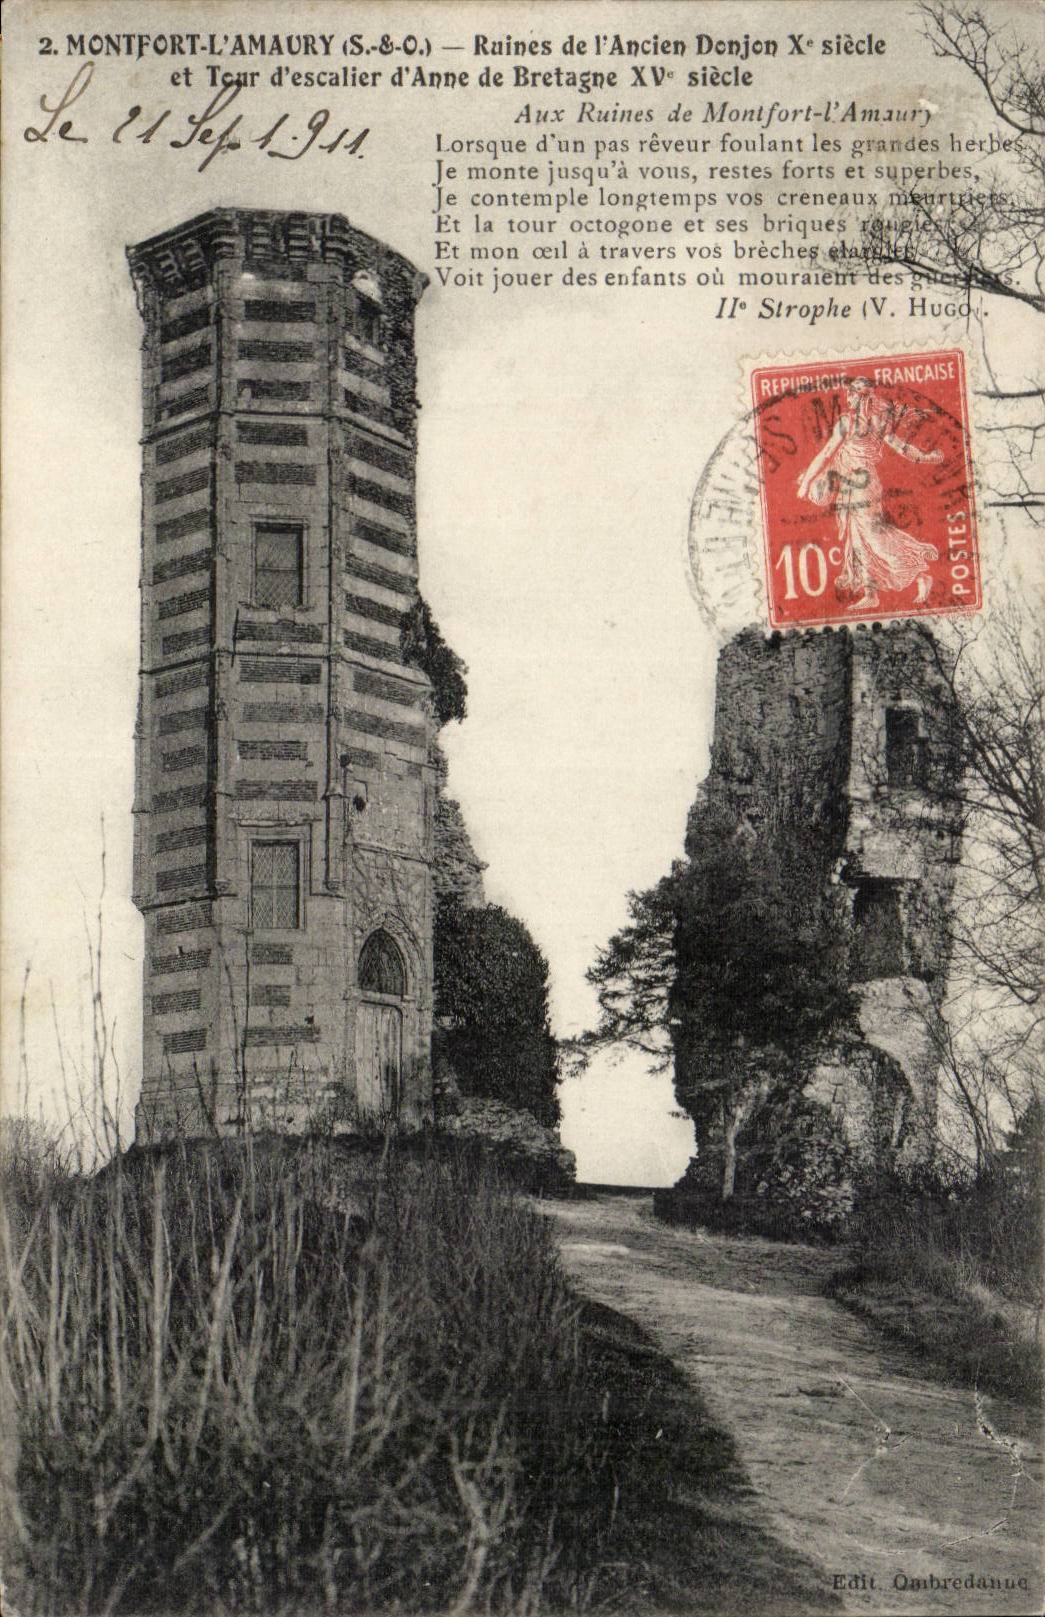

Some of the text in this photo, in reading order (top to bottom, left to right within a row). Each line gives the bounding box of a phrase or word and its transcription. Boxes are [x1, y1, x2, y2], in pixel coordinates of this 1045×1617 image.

[24, 61, 94, 143] Le
[873, 361, 956, 385] FRANÇAISE
[947, 510, 972, 597] POSTES
